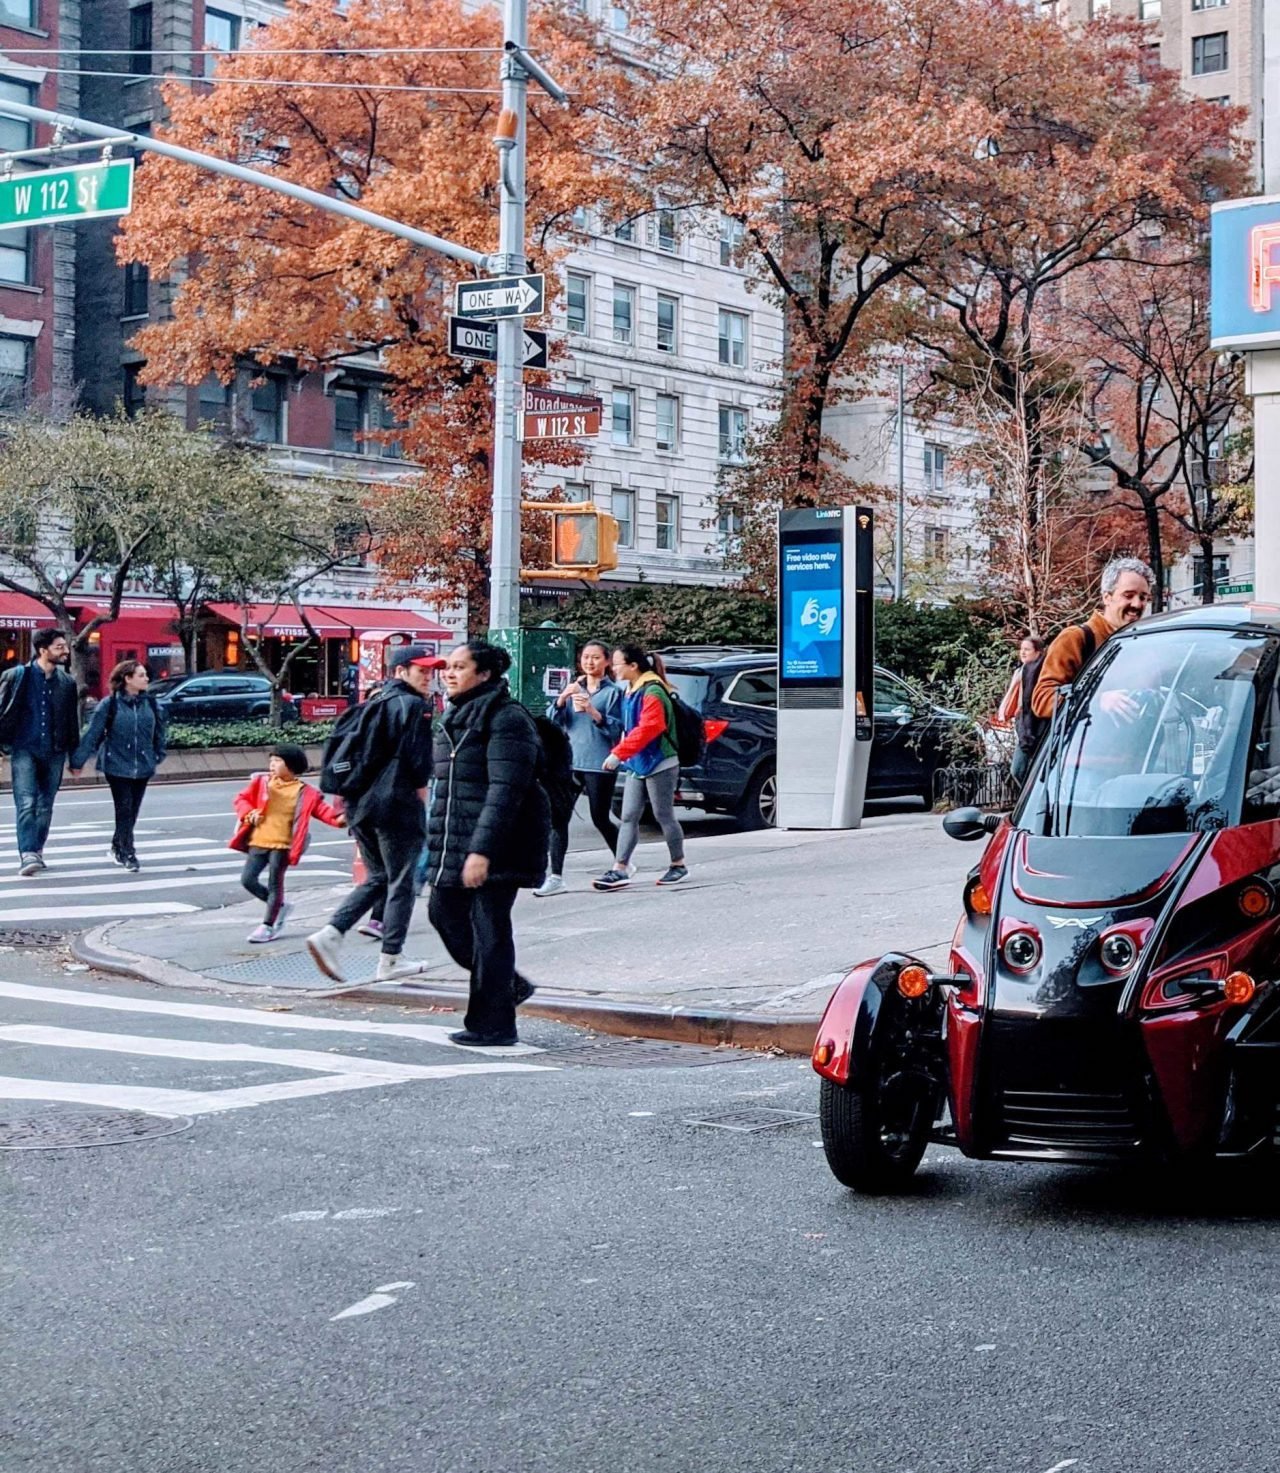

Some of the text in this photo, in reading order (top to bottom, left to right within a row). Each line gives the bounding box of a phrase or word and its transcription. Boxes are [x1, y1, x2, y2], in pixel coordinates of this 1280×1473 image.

[15, 175, 98, 215] W 112 St
[469, 288, 530, 308] ONE WAY
[464, 331, 493, 349] ONE
[537, 415, 586, 436] W 112 St
[816, 509, 841, 518] LinkNYC
[786, 551, 837, 562] Free video relay
[786, 562, 813, 571] services
[274, 627, 321, 637] PÂTISSEE
